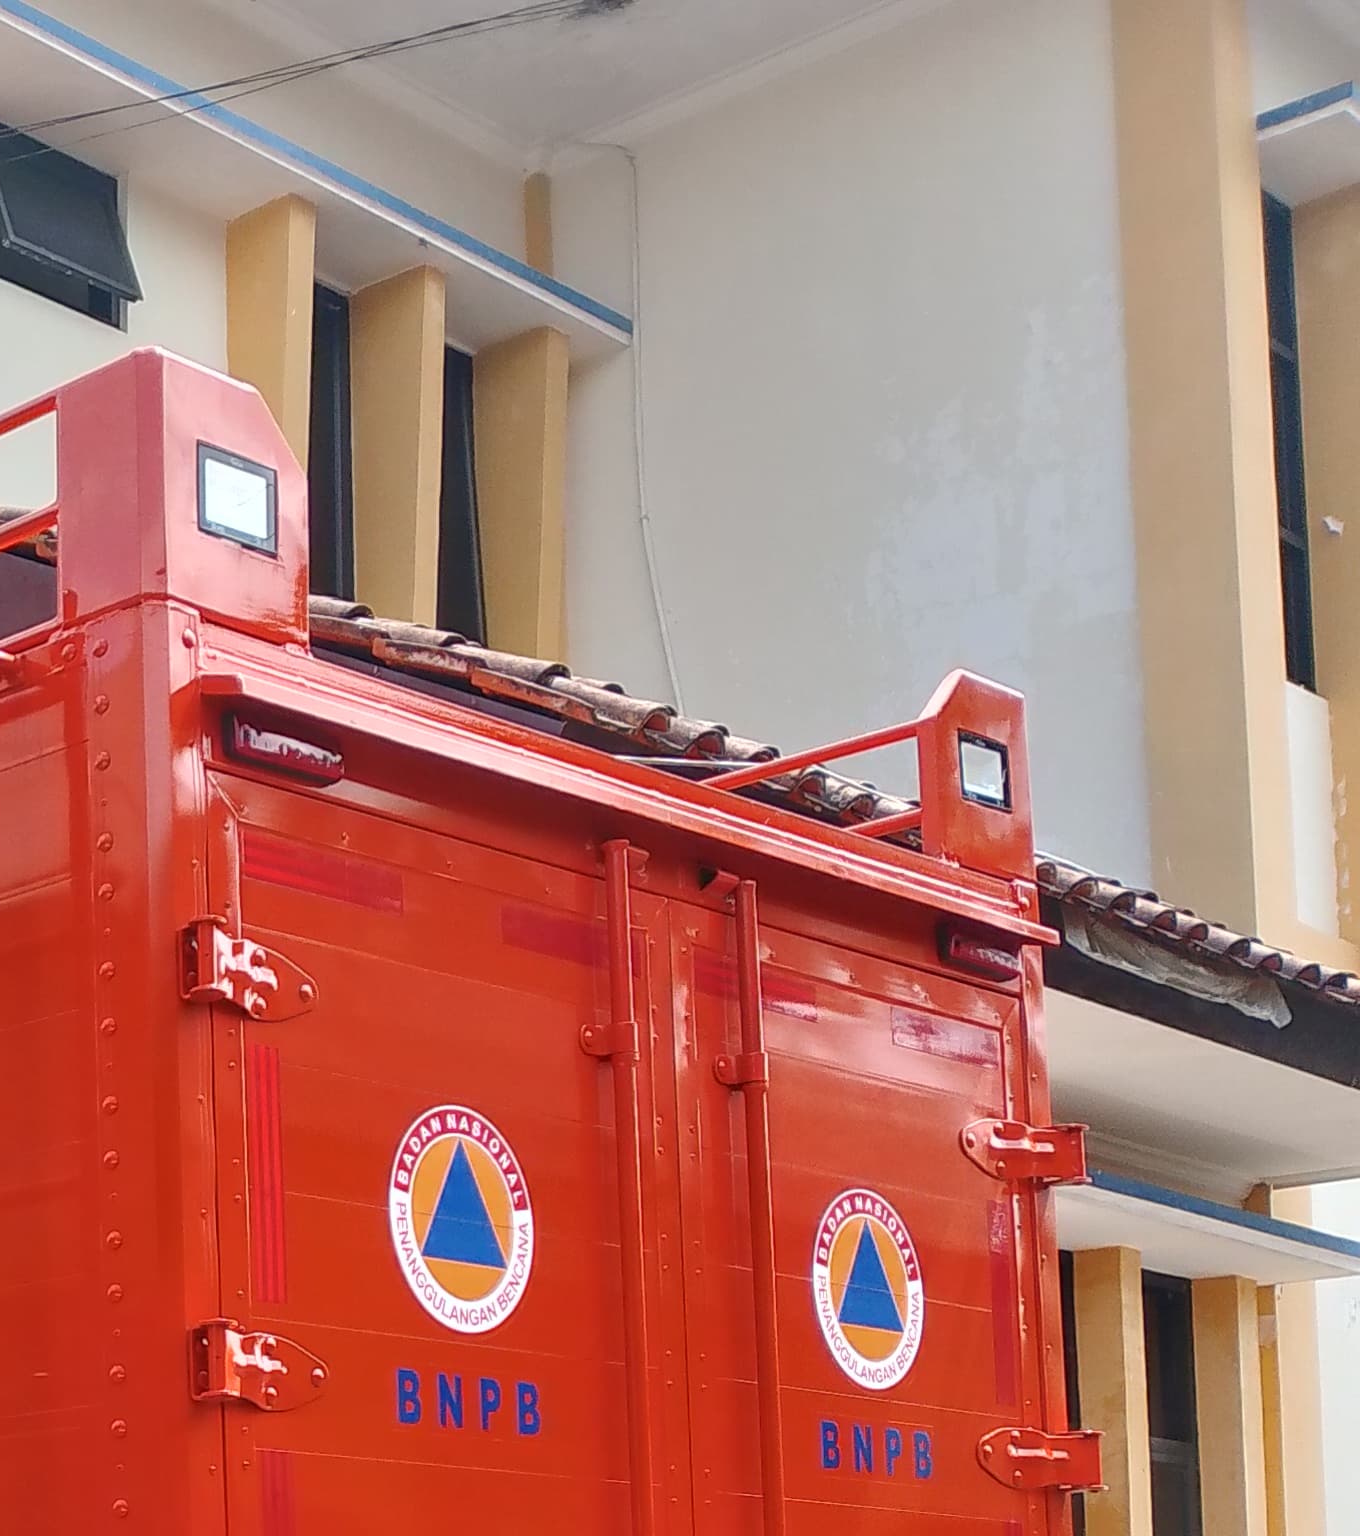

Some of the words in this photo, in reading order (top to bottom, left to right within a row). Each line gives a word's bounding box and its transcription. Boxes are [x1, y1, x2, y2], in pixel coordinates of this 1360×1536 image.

[398, 1115, 441, 1185] BADAN
[446, 1113, 524, 1207] NASIONAL
[395, 1201, 499, 1326] PENANGGULANGAN
[497, 1222, 529, 1314] BENCANA
[819, 1202, 852, 1261] BADAN
[855, 1196, 915, 1276] NASIONAL
[817, 1274, 897, 1384] PENANGGULANGAN
[896, 1290, 920, 1372] BENCANA
[395, 1367, 541, 1436] BNPB
[820, 1419, 933, 1480] BNPB
